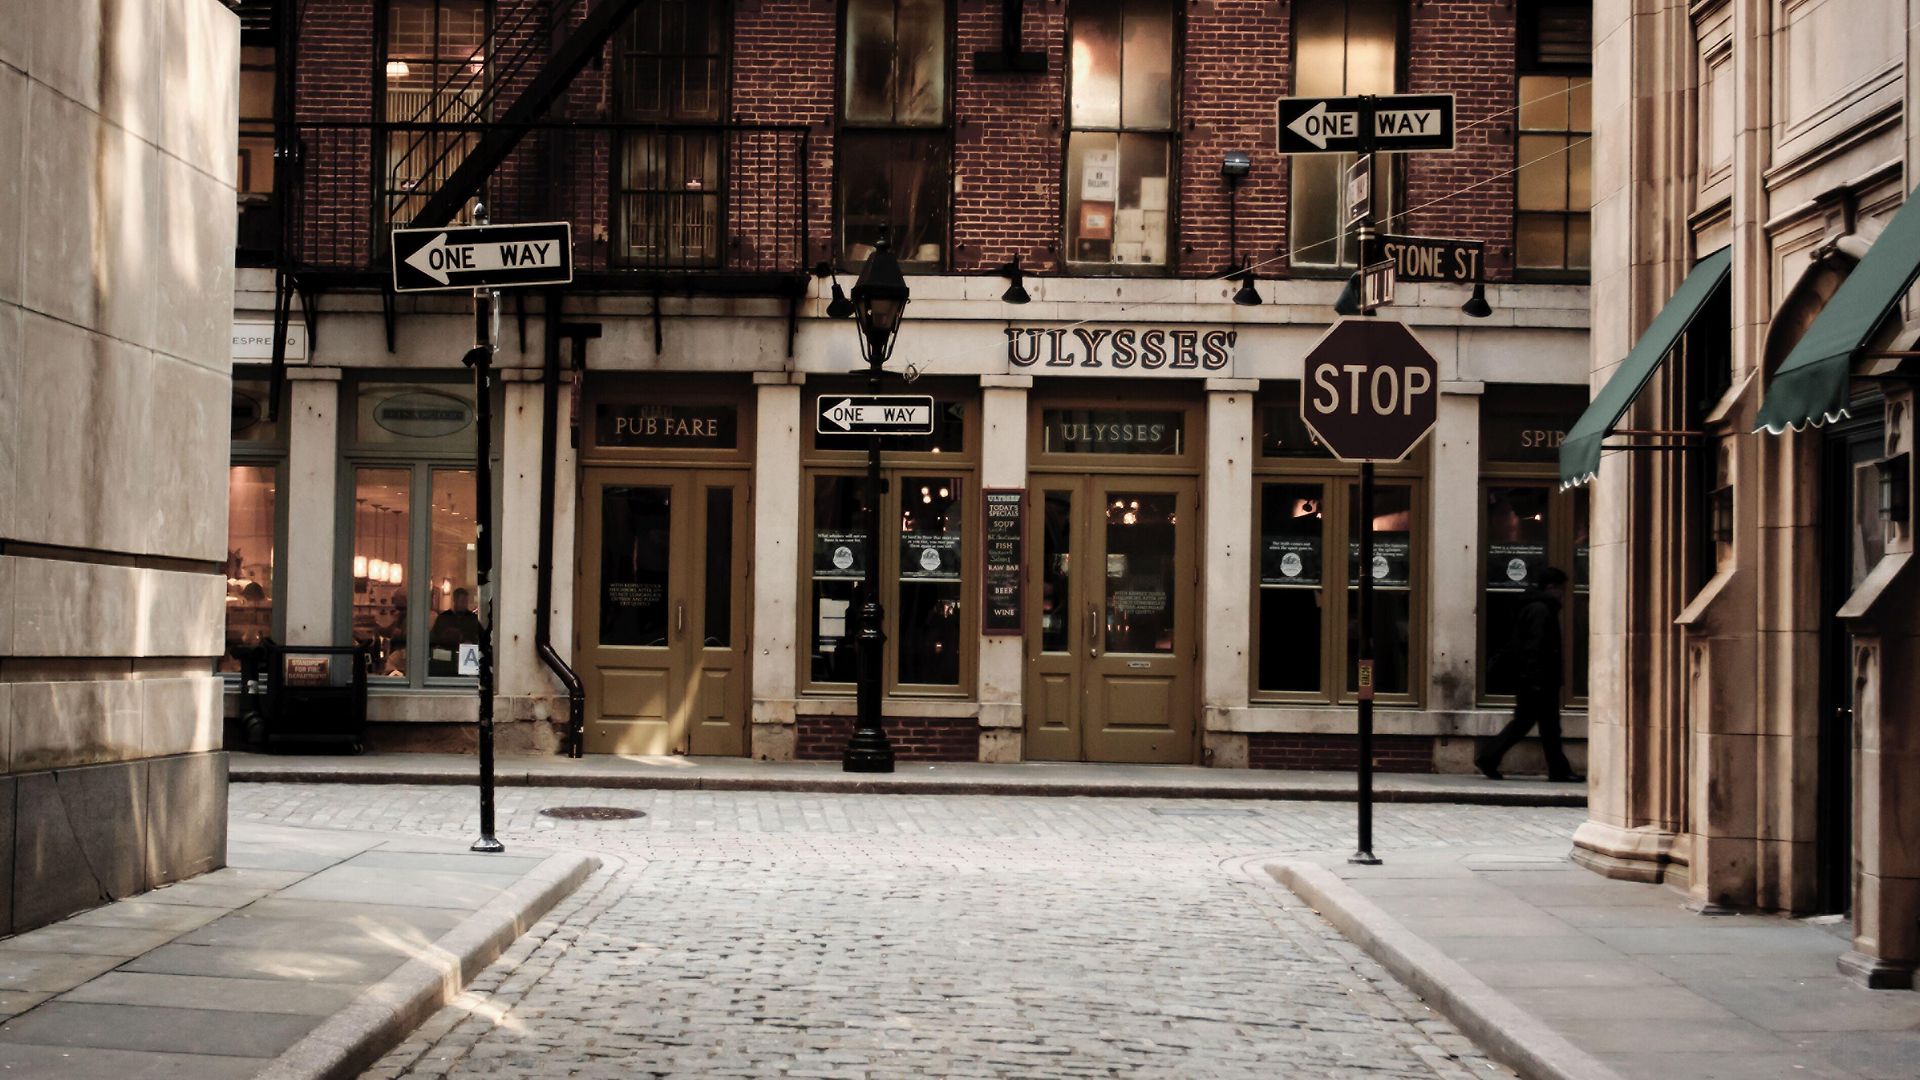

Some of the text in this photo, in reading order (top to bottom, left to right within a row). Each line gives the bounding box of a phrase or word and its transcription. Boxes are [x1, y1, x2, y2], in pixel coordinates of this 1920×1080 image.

[1304, 112, 1431, 137] ONE WAY
[428, 242, 550, 270] ONE WAY
[1384, 242, 1480, 280] STONE ST
[232, 336, 296, 346] ESPREO
[1312, 362, 1432, 417] STOP
[833, 407, 917, 423] ONE WAY
[615, 416, 718, 437] PUB FARE
[993, 520, 1015, 528] SOUP
[994, 608, 1015, 616] WINE
[463, 647, 478, 666] A
